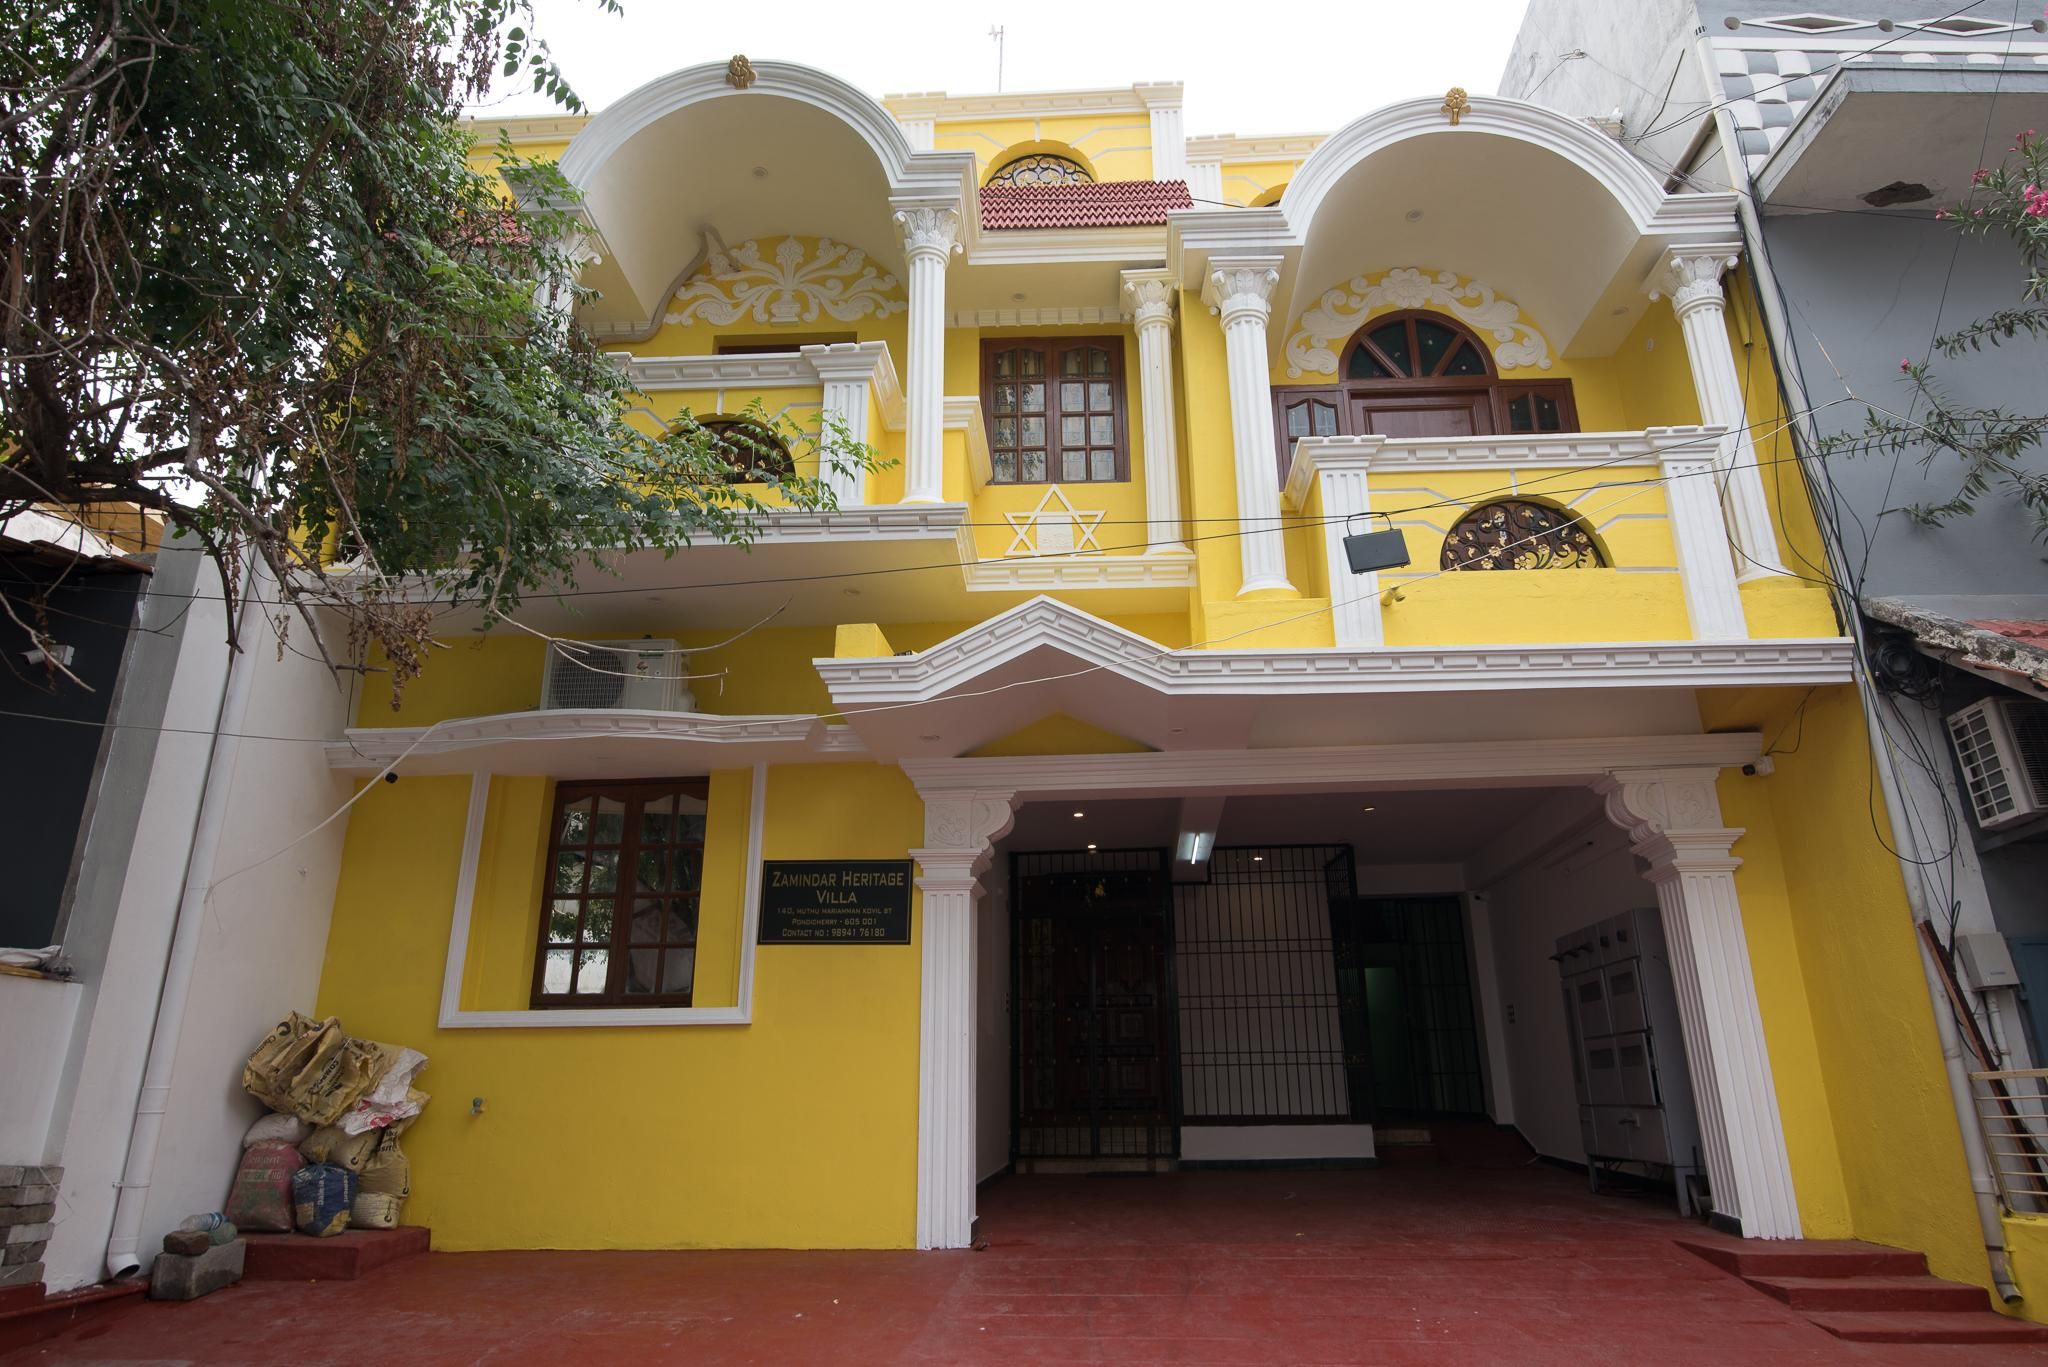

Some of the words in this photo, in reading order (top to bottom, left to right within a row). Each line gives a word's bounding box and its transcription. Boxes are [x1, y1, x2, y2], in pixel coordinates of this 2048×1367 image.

[772, 871, 837, 887] ZAMINDAR
[842, 871, 905, 887] HERITAGE
[816, 889, 858, 904] VILLA
[792, 918, 838, 926] PONDICHERRY
[844, 918, 861, 926] 605
[862, 918, 877, 926] 001
[782, 928, 812, 937] CONTACT
